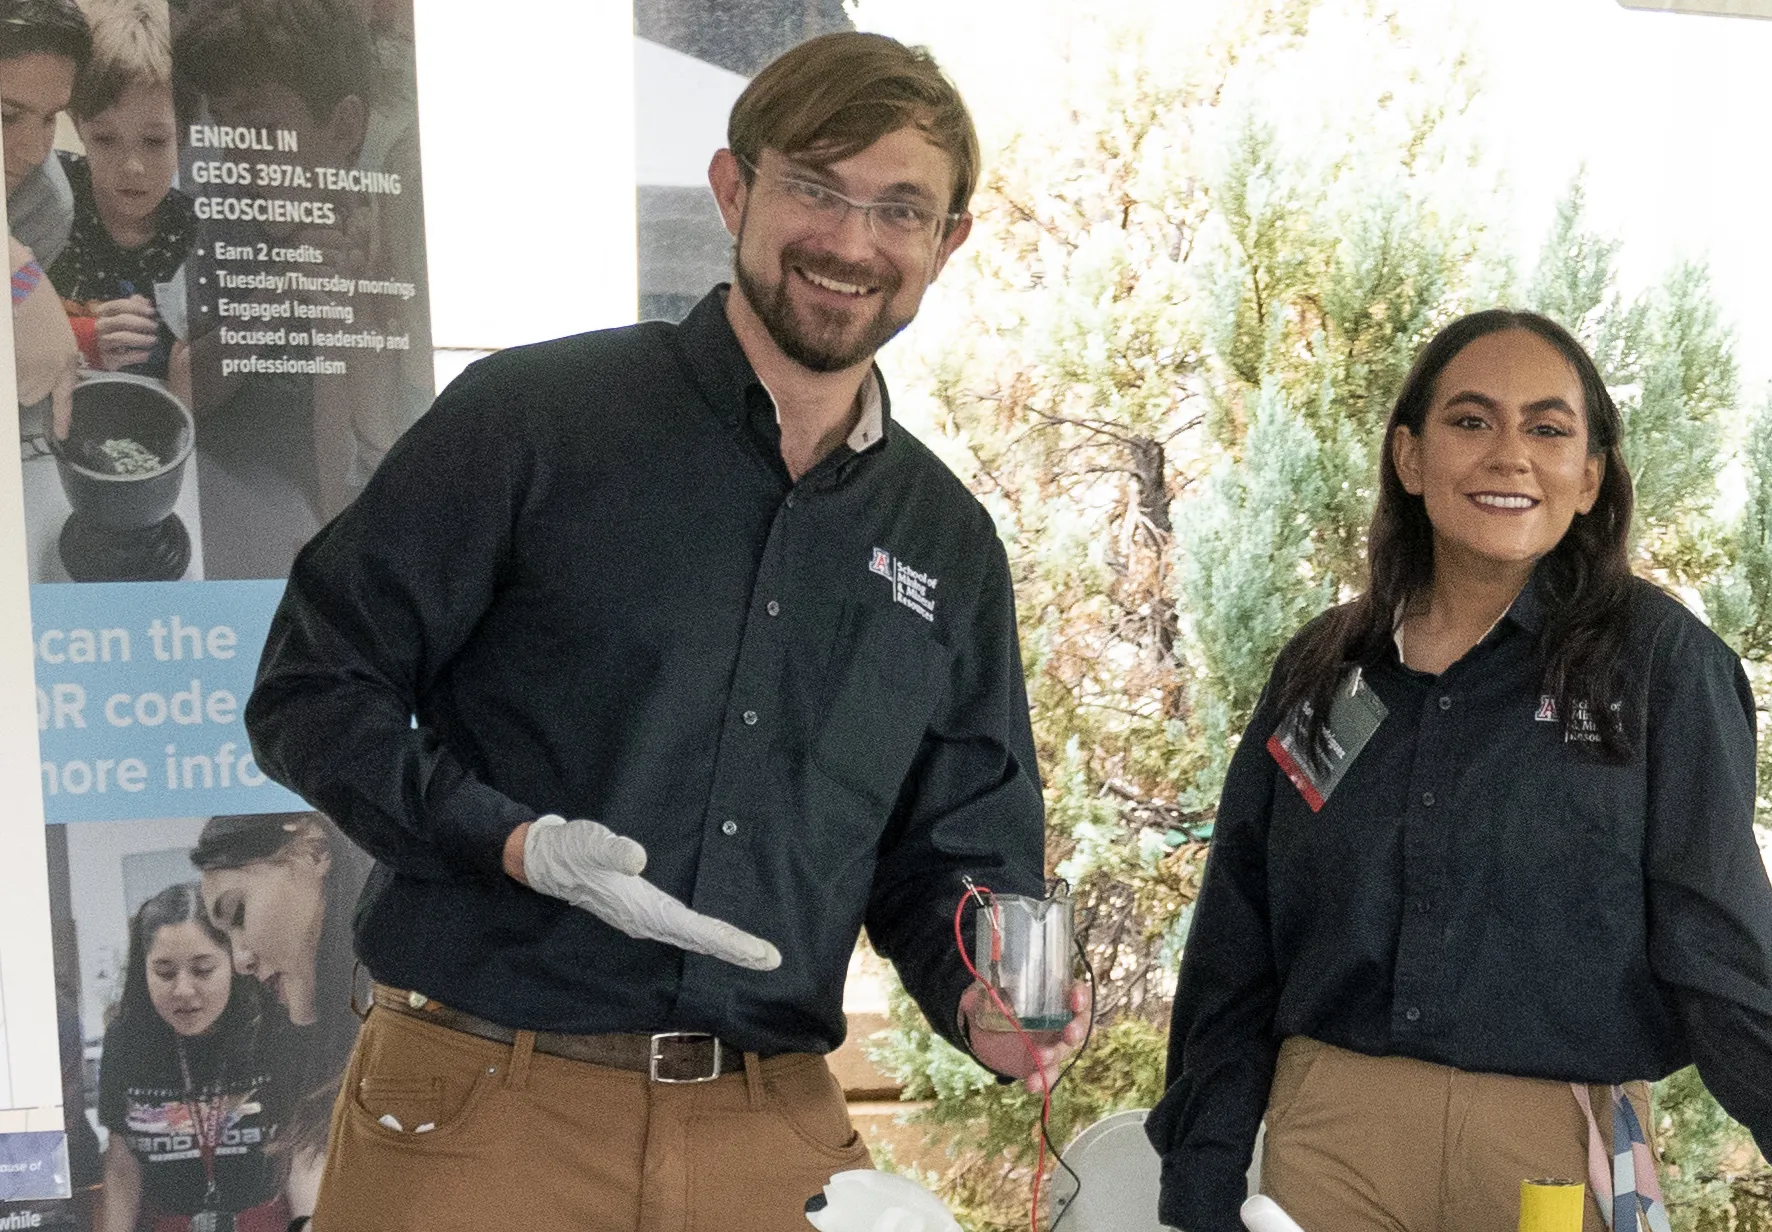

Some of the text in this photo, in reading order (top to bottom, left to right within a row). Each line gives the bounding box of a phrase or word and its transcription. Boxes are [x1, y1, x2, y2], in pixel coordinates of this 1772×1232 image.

[190, 125, 298, 152] ENROLL IN
[193, 160, 402, 195] GEOS 397A: TEACHING
[194, 196, 336, 225] GEOSCIENCES
[215, 242, 324, 263] Earn 2 credits
[217, 269, 416, 297] Tuesday/Thursday mornings
[219, 299, 355, 324] Engaged learning
[220, 328, 410, 351] focused on leadership and
[221, 355, 347, 376] professionalism
[34, 616, 238, 664] can the
[104, 679, 238, 728] code
[165, 742, 270, 790] info
[29, 1160, 42, 1172] of
